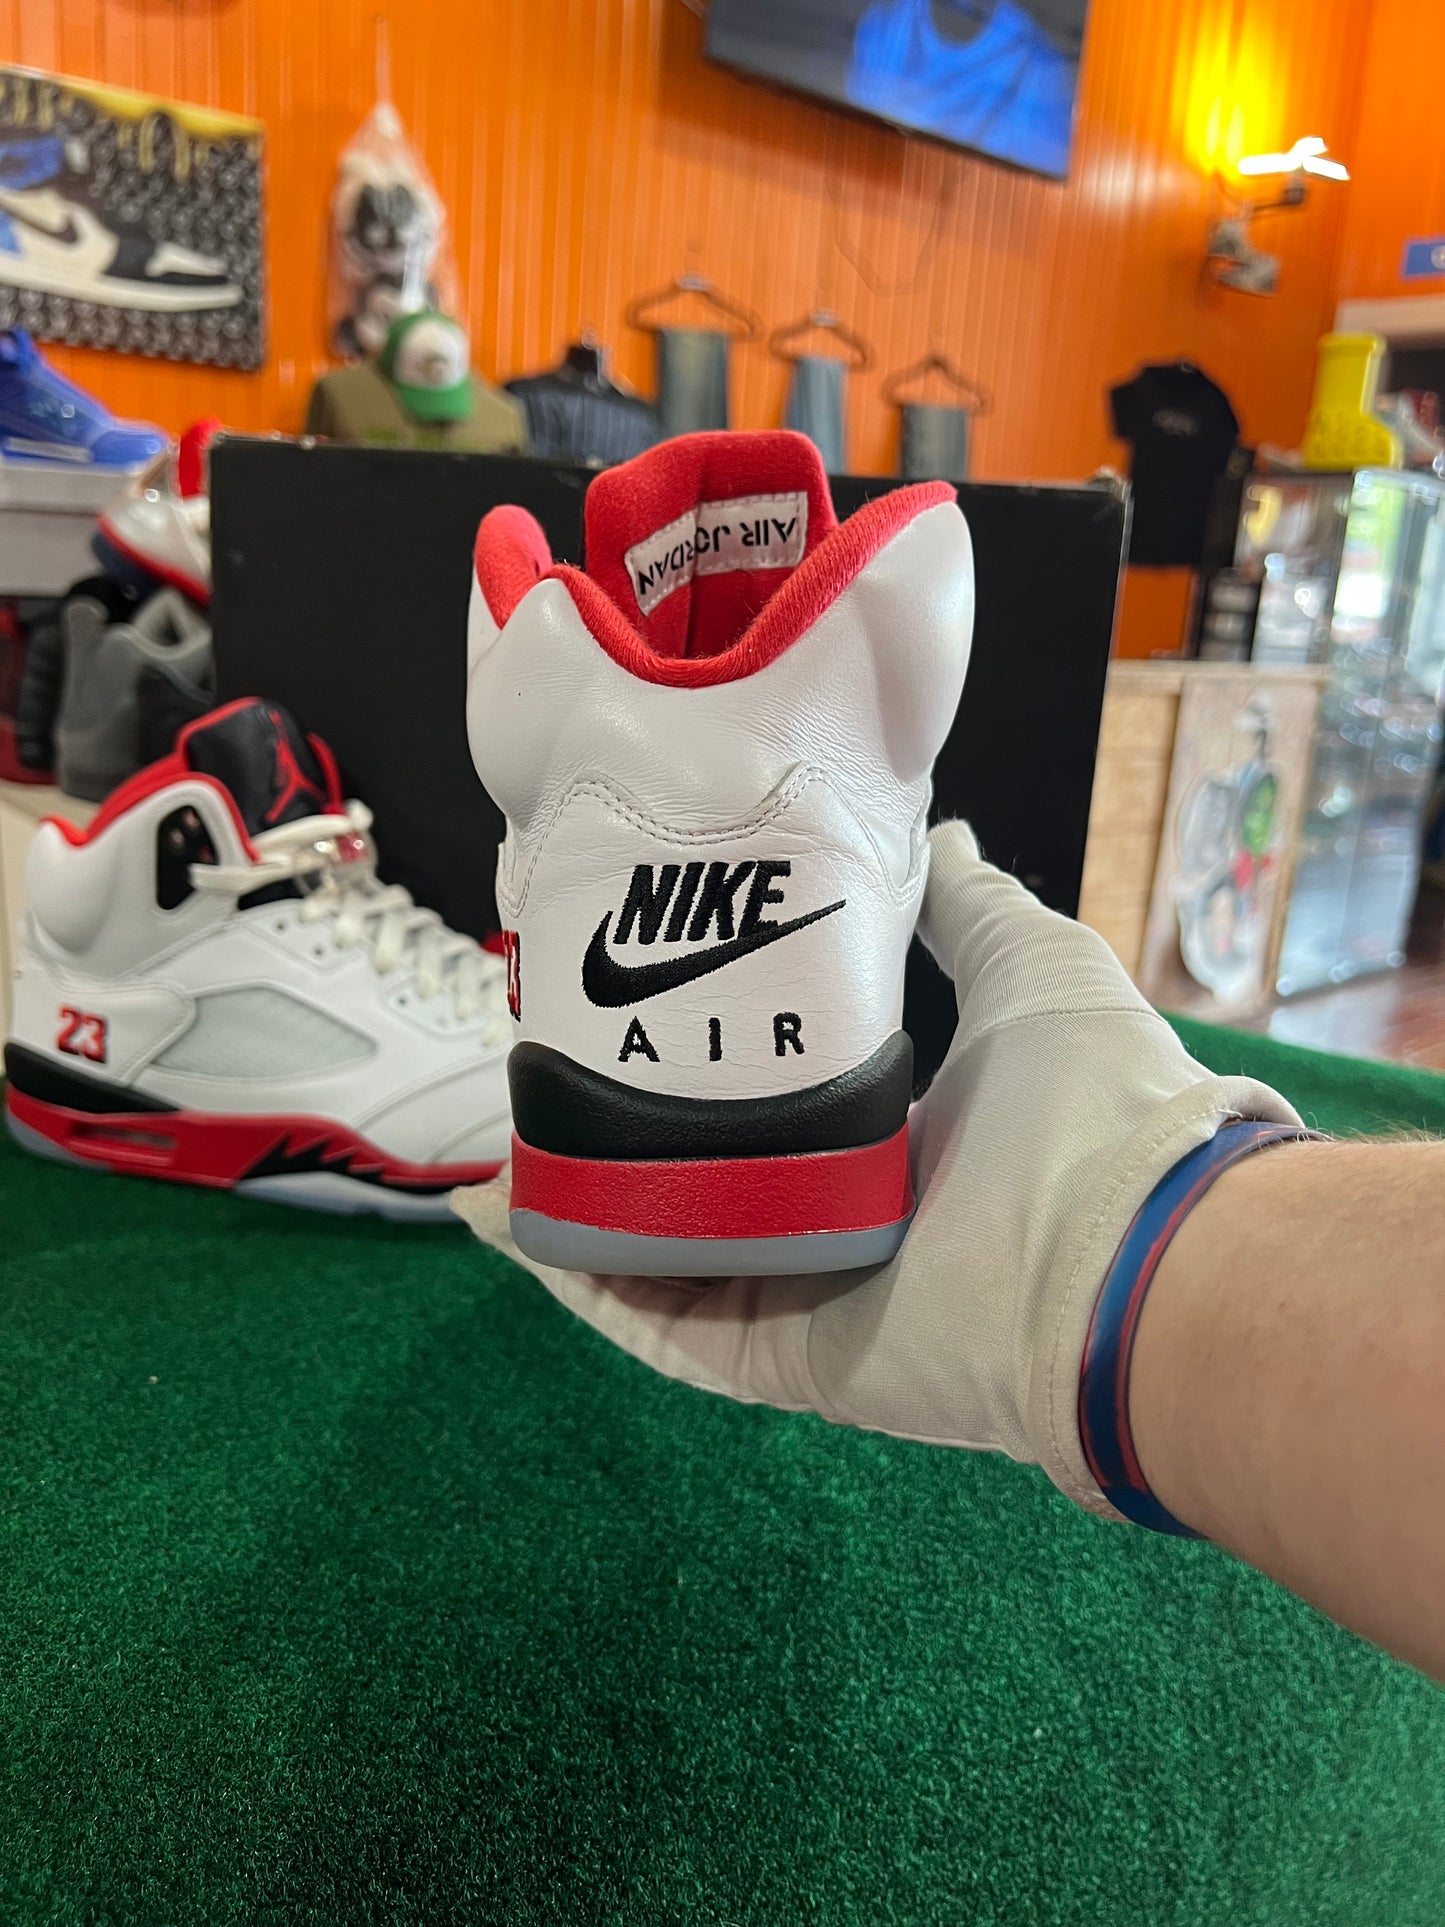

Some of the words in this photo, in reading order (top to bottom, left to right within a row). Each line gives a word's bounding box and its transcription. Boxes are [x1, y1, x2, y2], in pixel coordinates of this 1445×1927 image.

[637, 525, 730, 595] JORDAN
[739, 517, 797, 547] AIR
[613, 860, 791, 943] NIKE
[57, 1006, 107, 1064] 23
[617, 1012, 805, 1062] AIR
